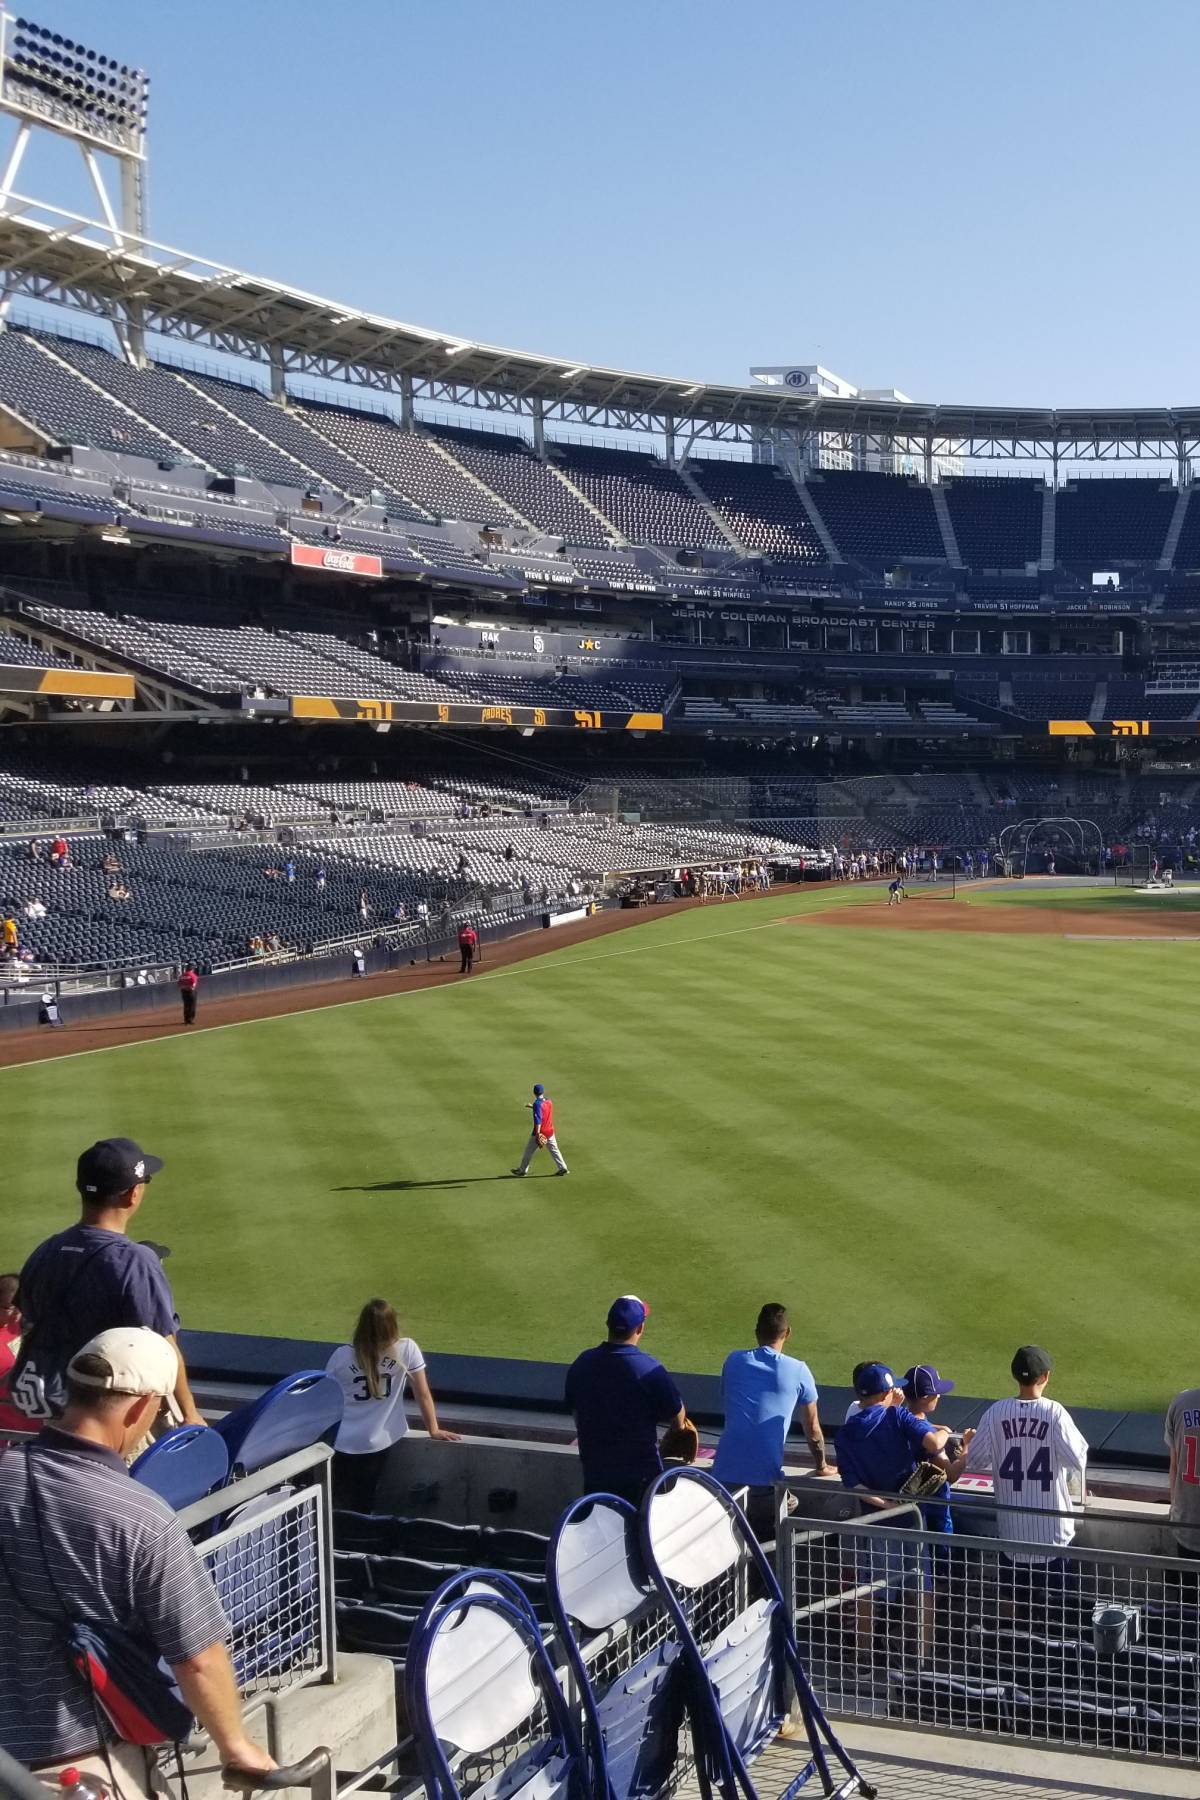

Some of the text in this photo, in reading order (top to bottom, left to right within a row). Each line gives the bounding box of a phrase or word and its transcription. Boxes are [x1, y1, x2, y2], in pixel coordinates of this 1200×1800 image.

[524, 571, 544, 581] STEVE
[551, 575, 573, 584] GARVEY
[608, 581, 657, 592] TONY 19 GWYNN
[694, 589, 751, 599] DAVE 31 WINFIELD
[884, 600, 905, 608] RANDY
[907, 600, 917, 608] 35
[1000, 603, 1008, 611] 51
[672, 608, 936, 630] JERRY COLEMAN BROADCAST CENTER
[481, 631, 500, 643] RAK
[481, 706, 512, 724] PADRES
[1001, 1416, 1050, 1441] RIZZO
[999, 1446, 1054, 1492] 44
